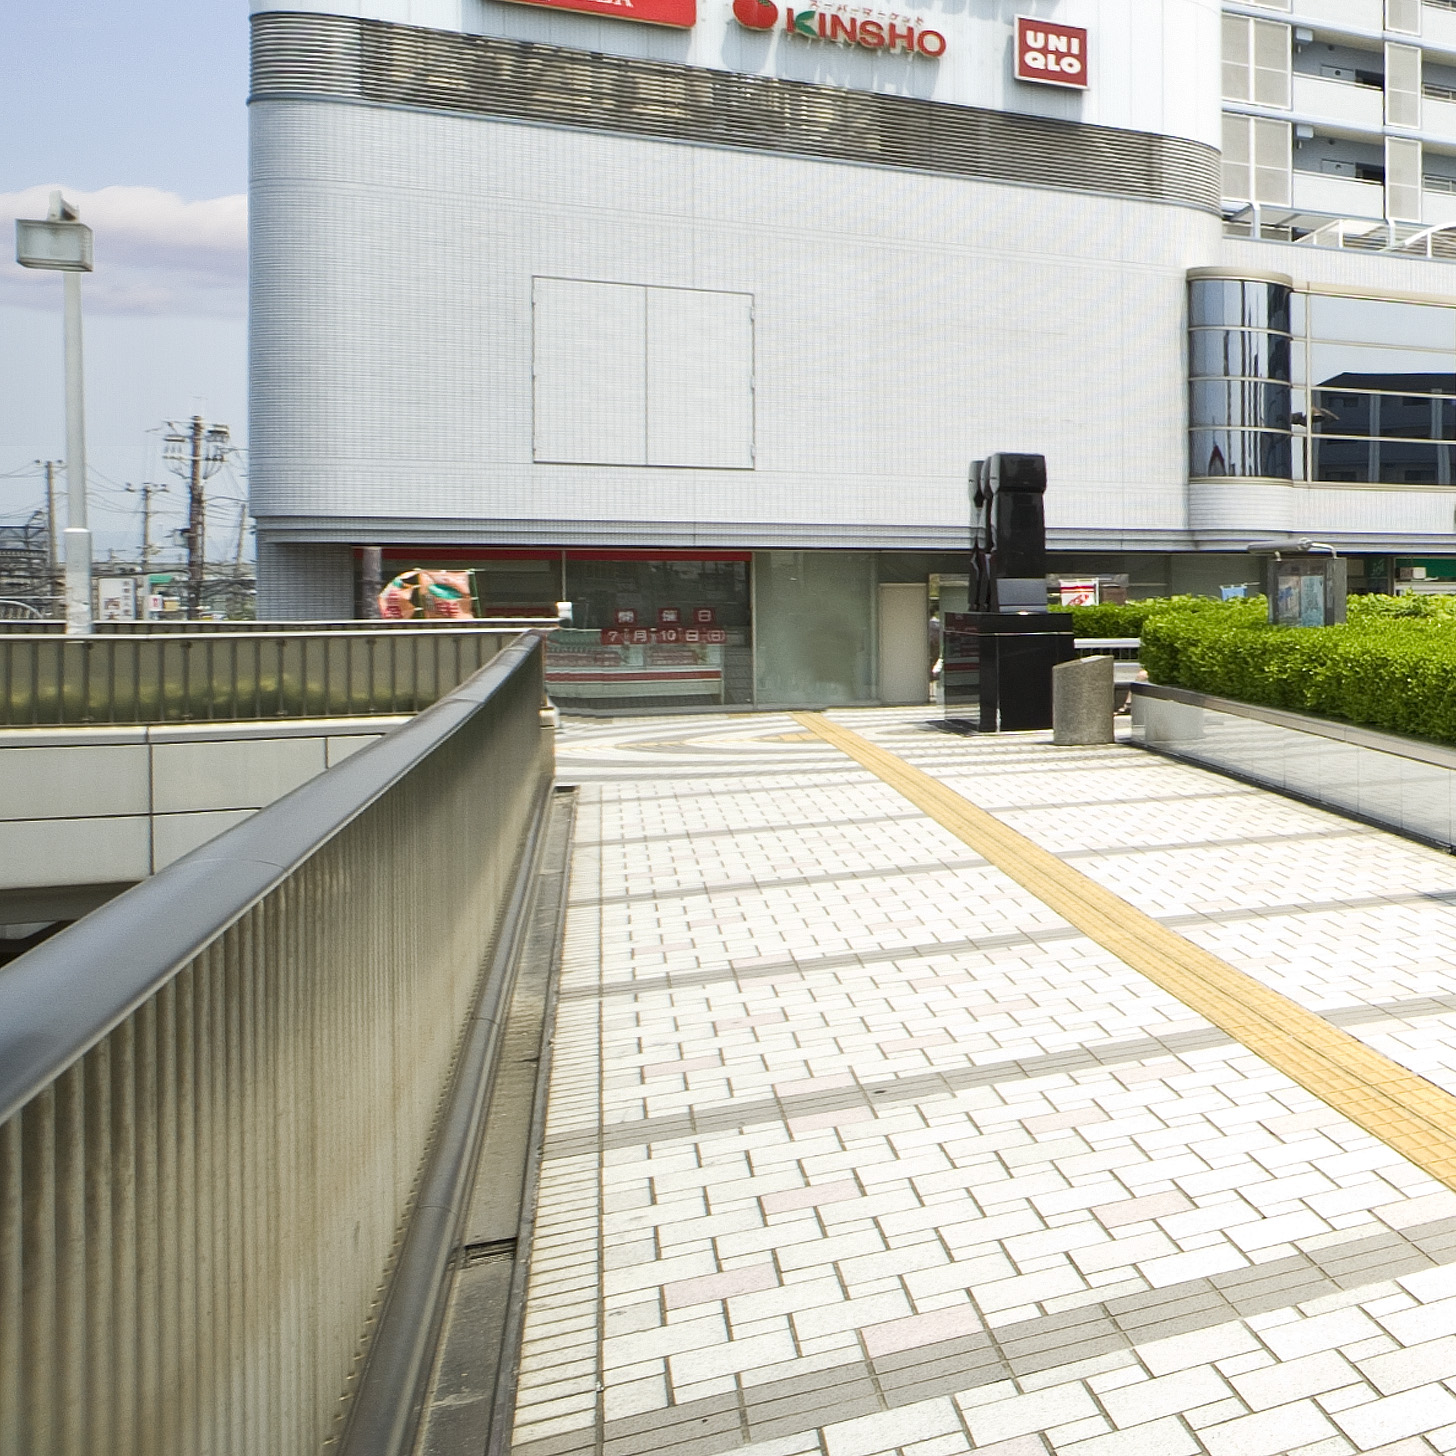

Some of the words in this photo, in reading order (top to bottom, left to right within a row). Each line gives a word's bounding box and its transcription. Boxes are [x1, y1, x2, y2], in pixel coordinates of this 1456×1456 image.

[785, 7, 948, 58] KINSHO
[1025, 30, 1081, 57] UNI
[1024, 50, 1082, 76] QLO
